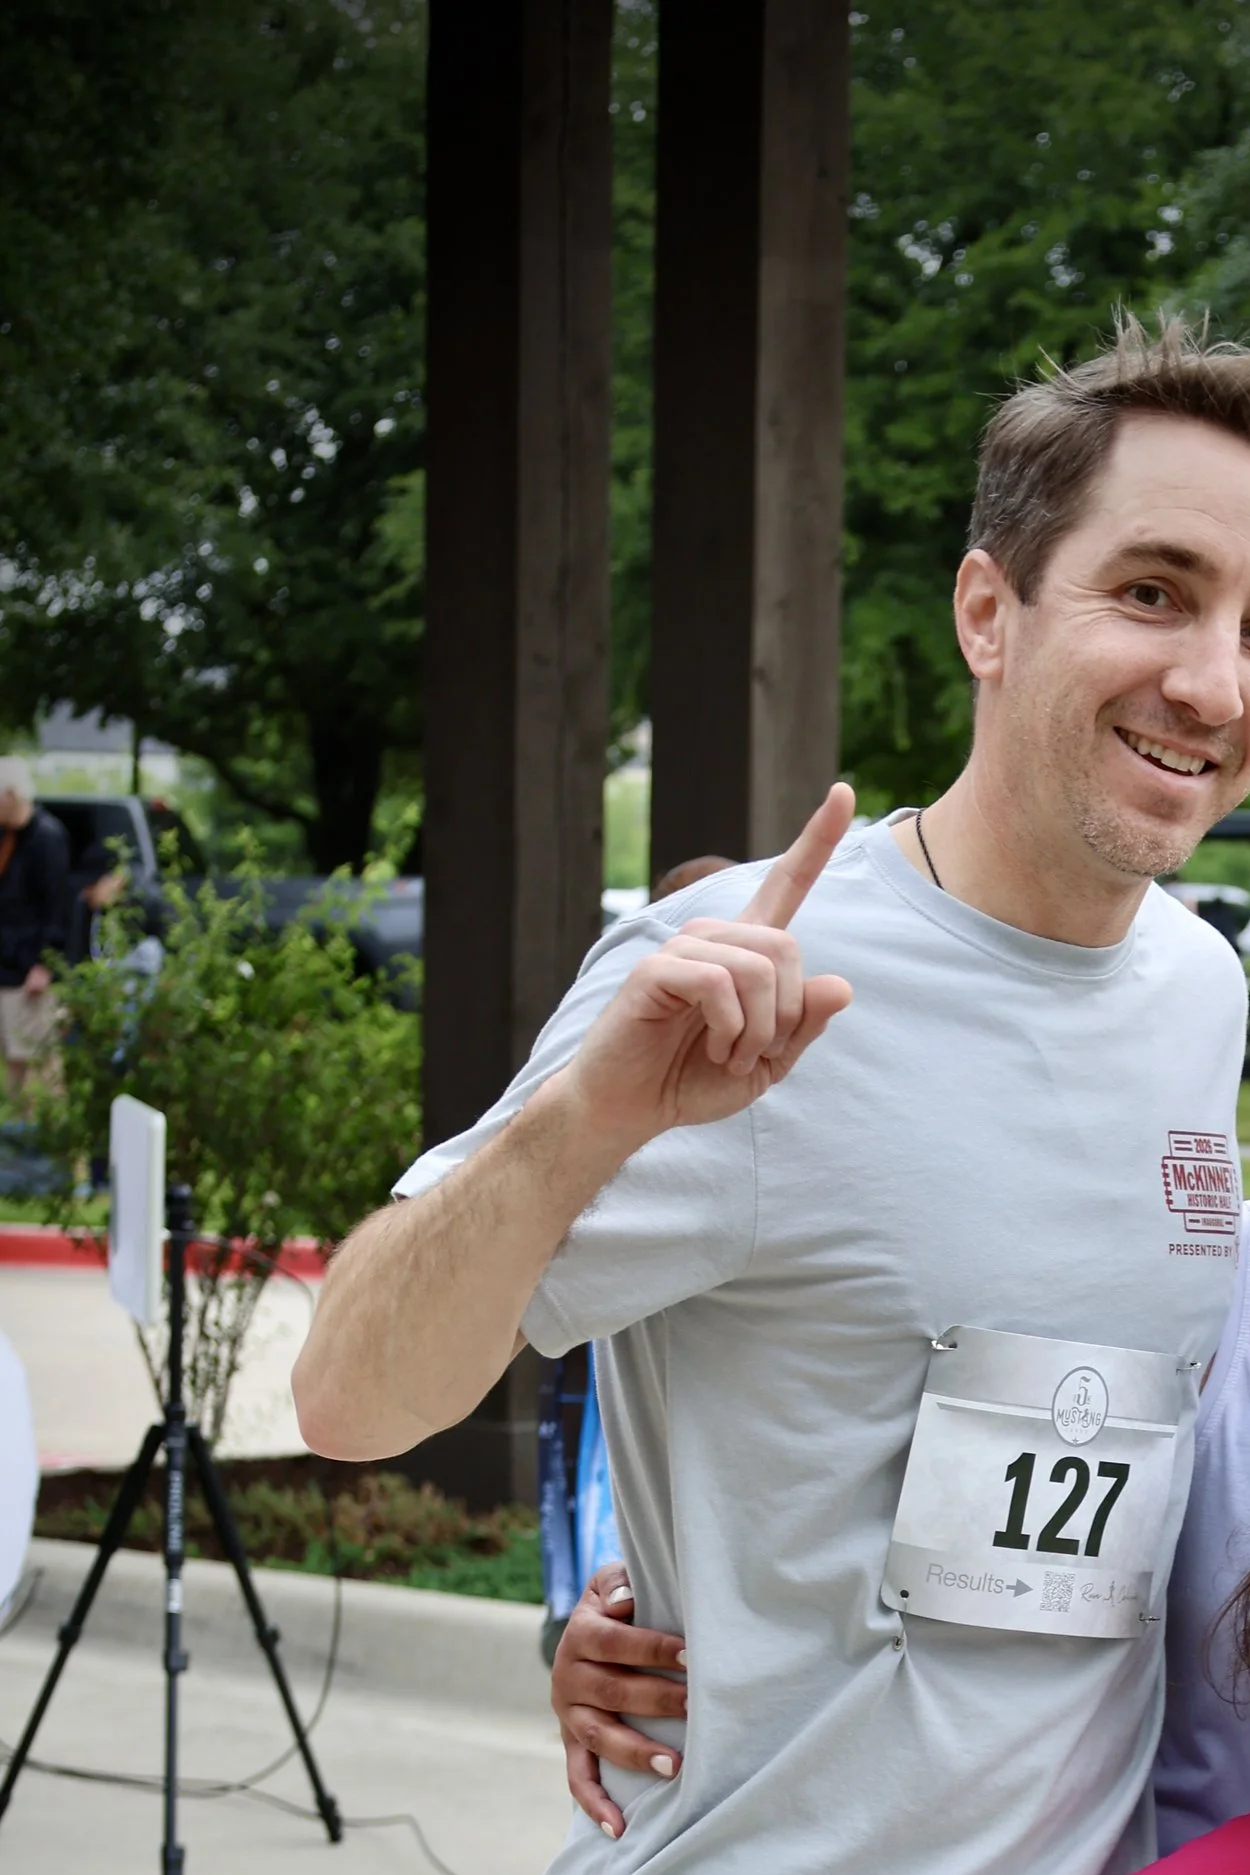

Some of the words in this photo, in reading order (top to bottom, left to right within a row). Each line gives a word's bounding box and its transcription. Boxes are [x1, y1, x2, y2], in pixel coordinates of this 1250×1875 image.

[1187, 1193, 1218, 1208] HISTORIC
[1169, 1243, 1222, 1257] PRESENTED
[1224, 1246, 1233, 1257] BY
[1056, 1407, 1101, 1428] MUSTANG
[992, 1452, 1131, 1558] 127
[925, 1563, 1005, 1594] Results
